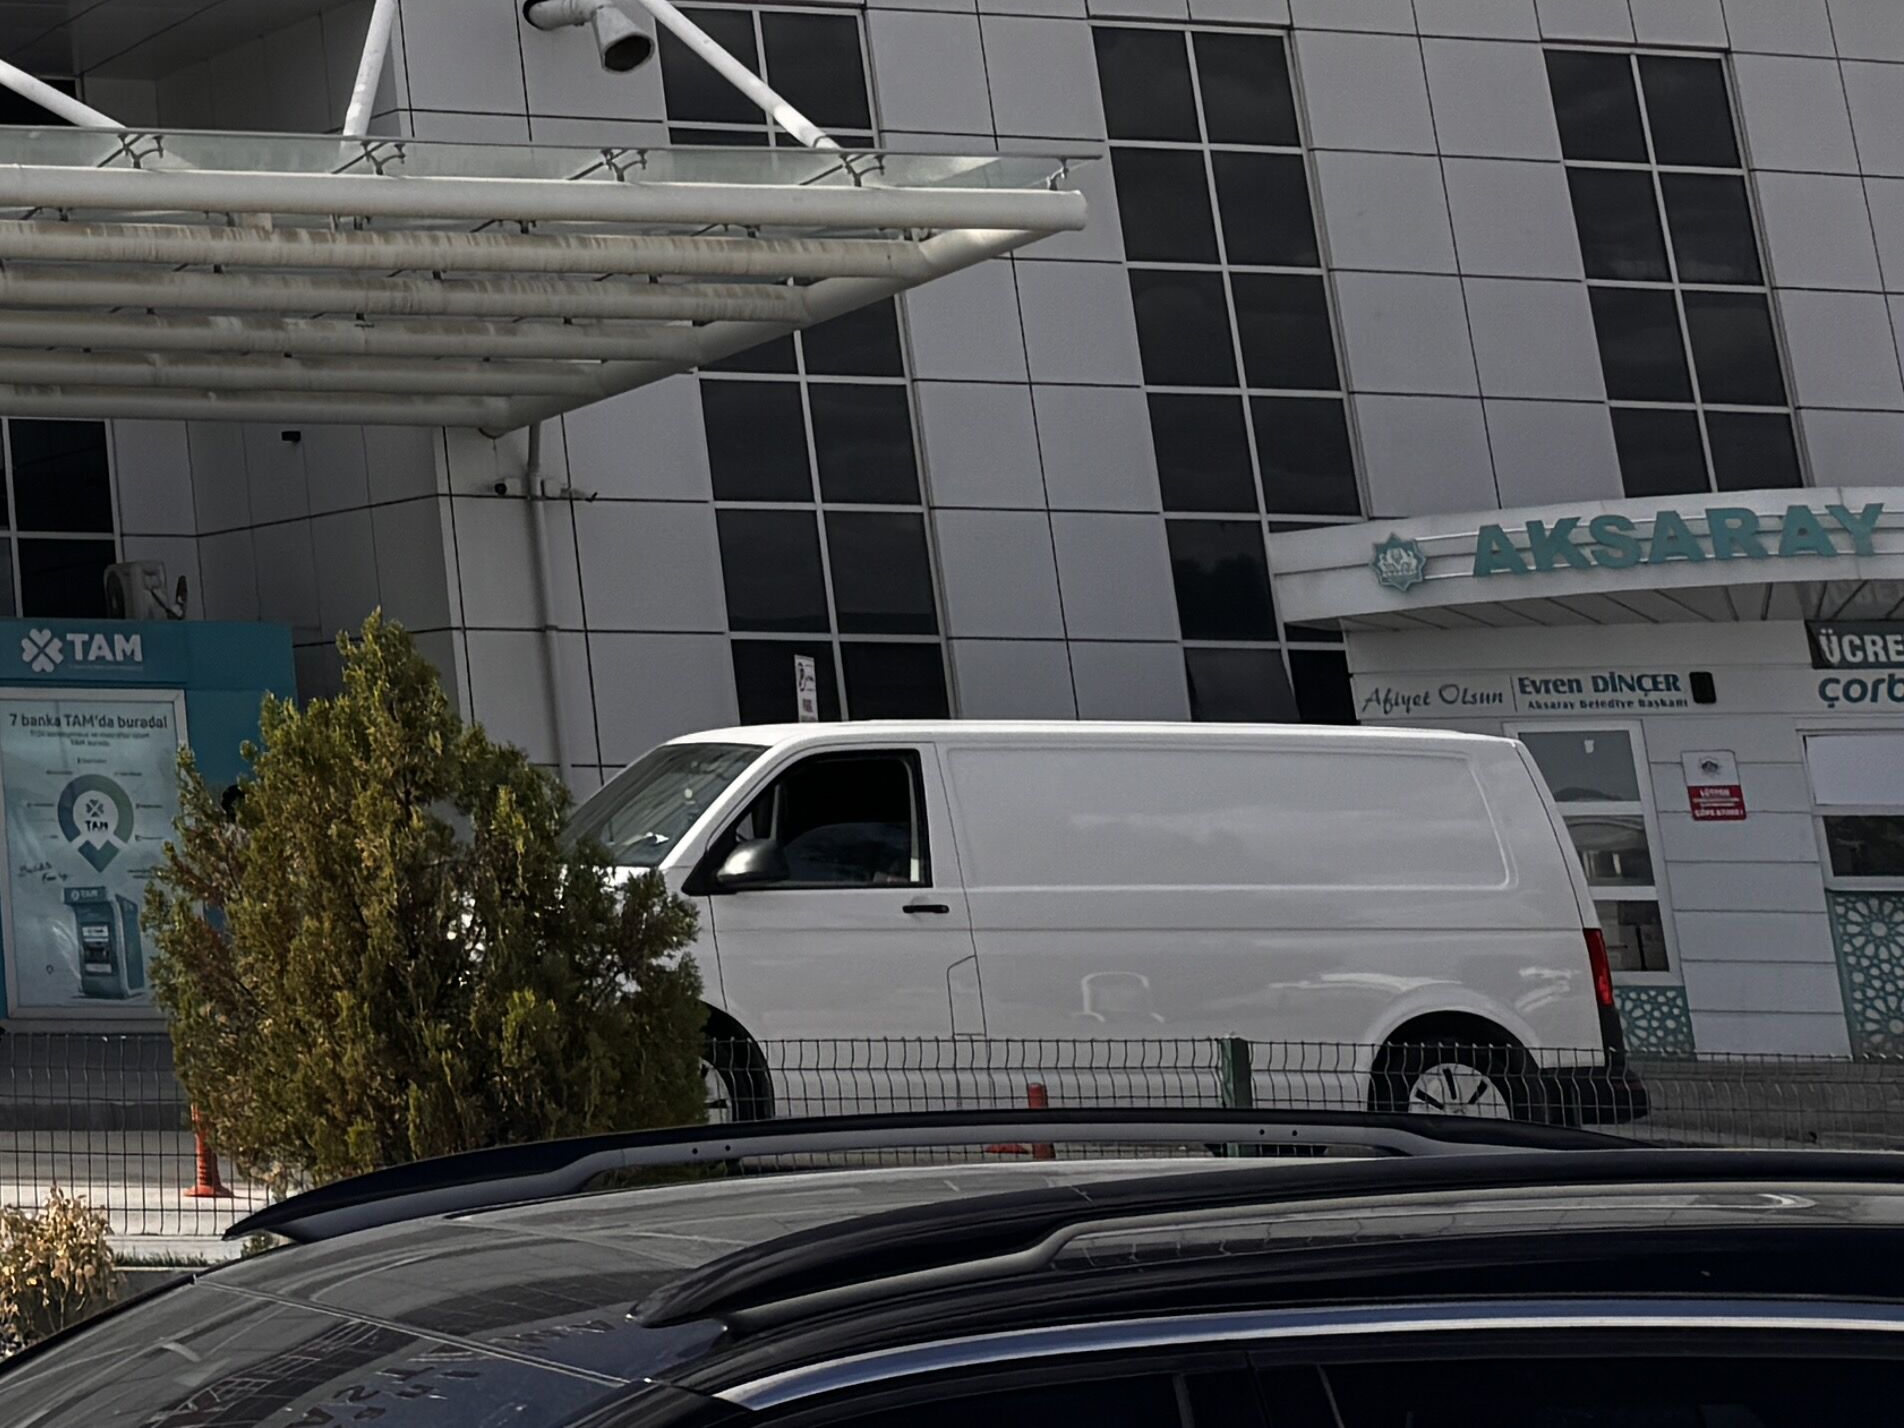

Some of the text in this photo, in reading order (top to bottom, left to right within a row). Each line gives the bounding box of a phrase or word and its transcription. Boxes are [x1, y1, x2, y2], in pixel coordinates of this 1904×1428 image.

[1473, 502, 1884, 577] AKSARAY
[65, 633, 143, 662] TAM
[1517, 671, 1681, 698] Evren DİNÇER
[1362, 683, 1504, 715] Afiyet Olsun
[1527, 697, 1689, 711] Aksaray Belediye Başkanı
[9, 713, 18, 727] 7
[21, 713, 61, 728] banka
[63, 713, 115, 729] TAM'da
[85, 821, 108, 832] TAM
